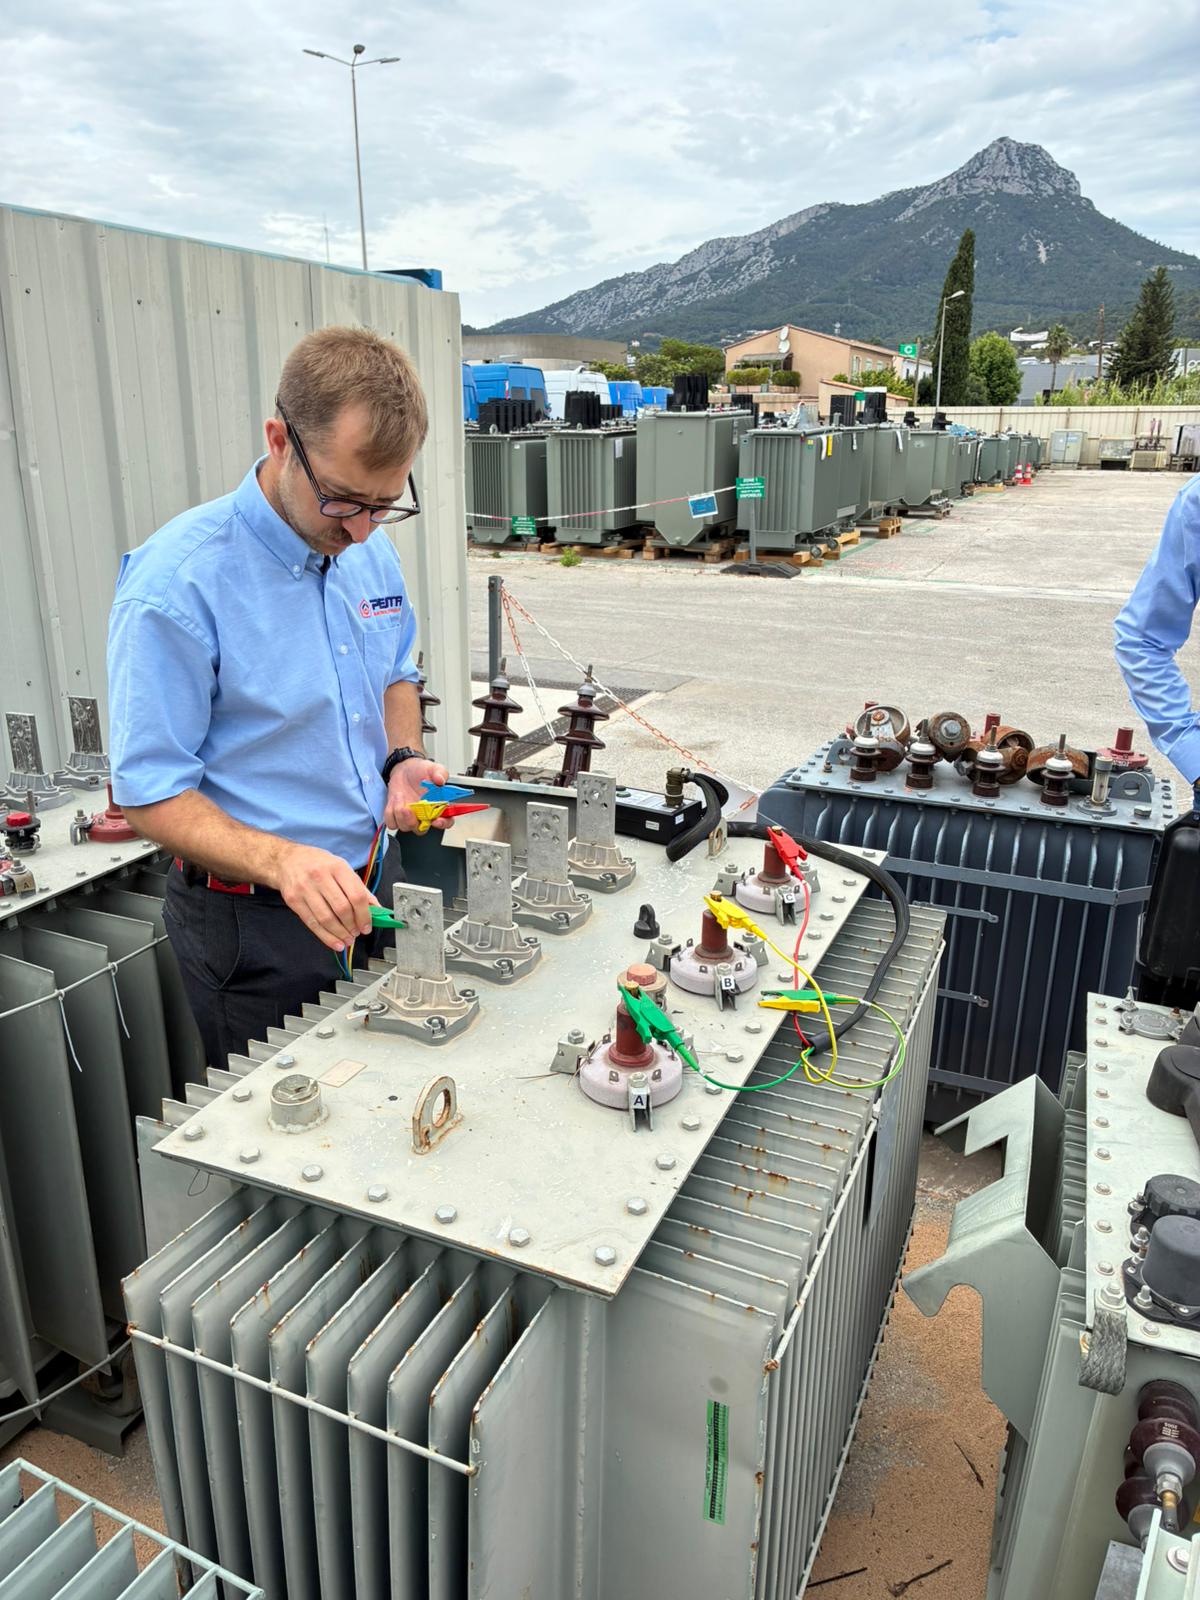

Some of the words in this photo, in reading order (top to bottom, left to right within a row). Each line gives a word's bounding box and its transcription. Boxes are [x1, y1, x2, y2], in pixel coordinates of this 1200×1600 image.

[786, 893, 794, 901] C
[724, 977, 732, 988] B
[633, 1095, 644, 1106] A
